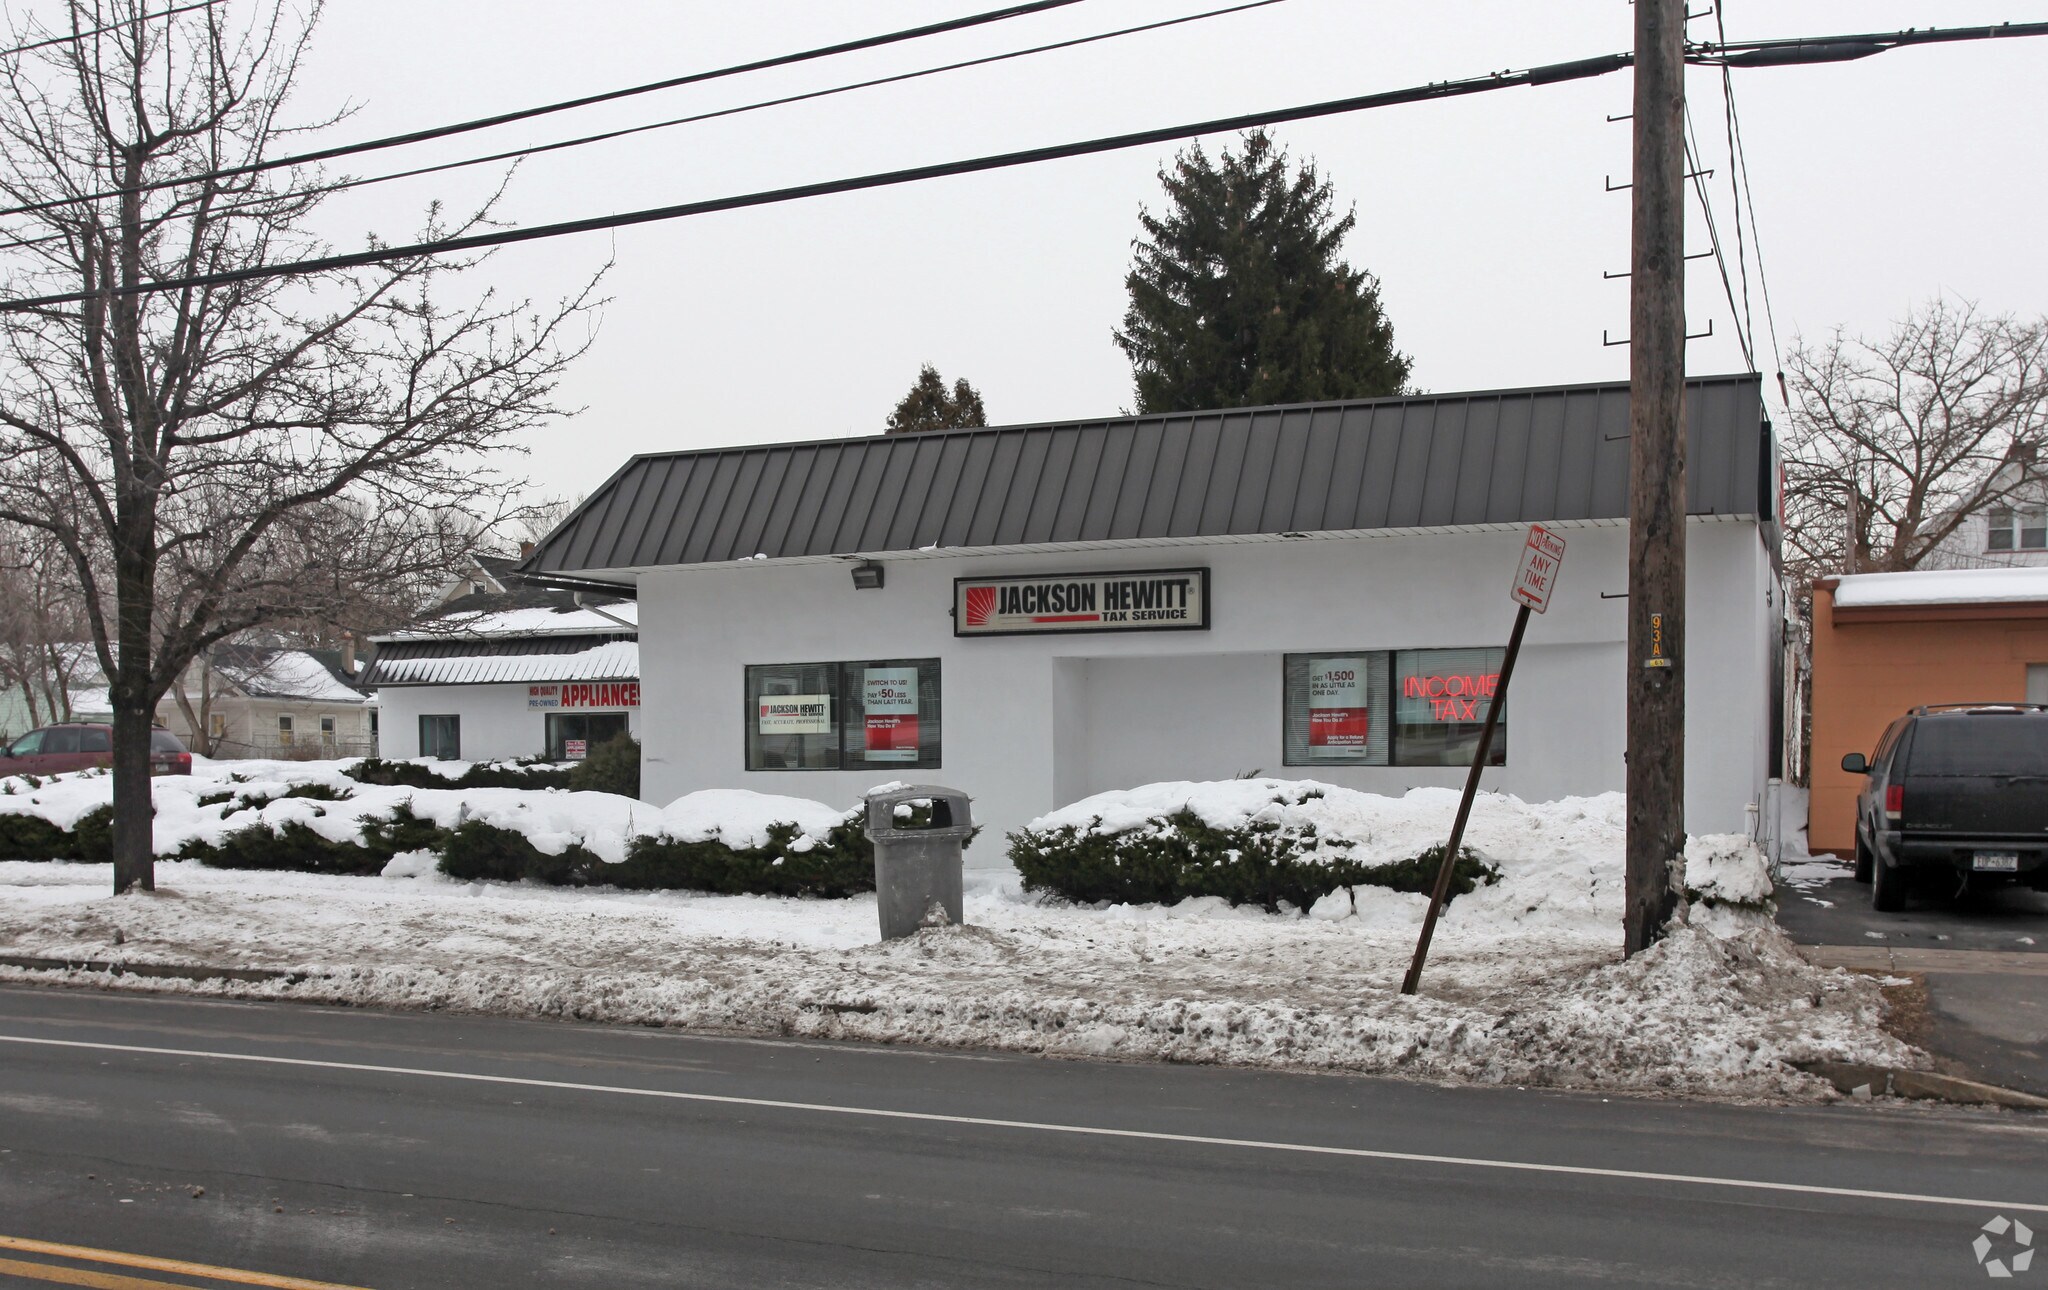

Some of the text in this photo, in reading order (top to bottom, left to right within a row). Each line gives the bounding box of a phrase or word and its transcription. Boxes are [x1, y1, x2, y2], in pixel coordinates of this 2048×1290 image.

[1529, 529, 1562, 556] NO PARKING
[1530, 554, 1552, 574] ANY
[1524, 568, 1548, 592] TIME
[998, 583, 1096, 614] JACKSON
[1102, 609, 1188, 622] TAX SERVICE
[1652, 616, 1661, 656] 93A
[1325, 671, 1354, 682] $1,500
[1404, 673, 1501, 698] INCOME
[540, 686, 558, 697] QUALITY
[878, 689, 894, 698] $50
[770, 704, 824, 714] JACKSON HEWITT
[1429, 699, 1477, 721] TAX
